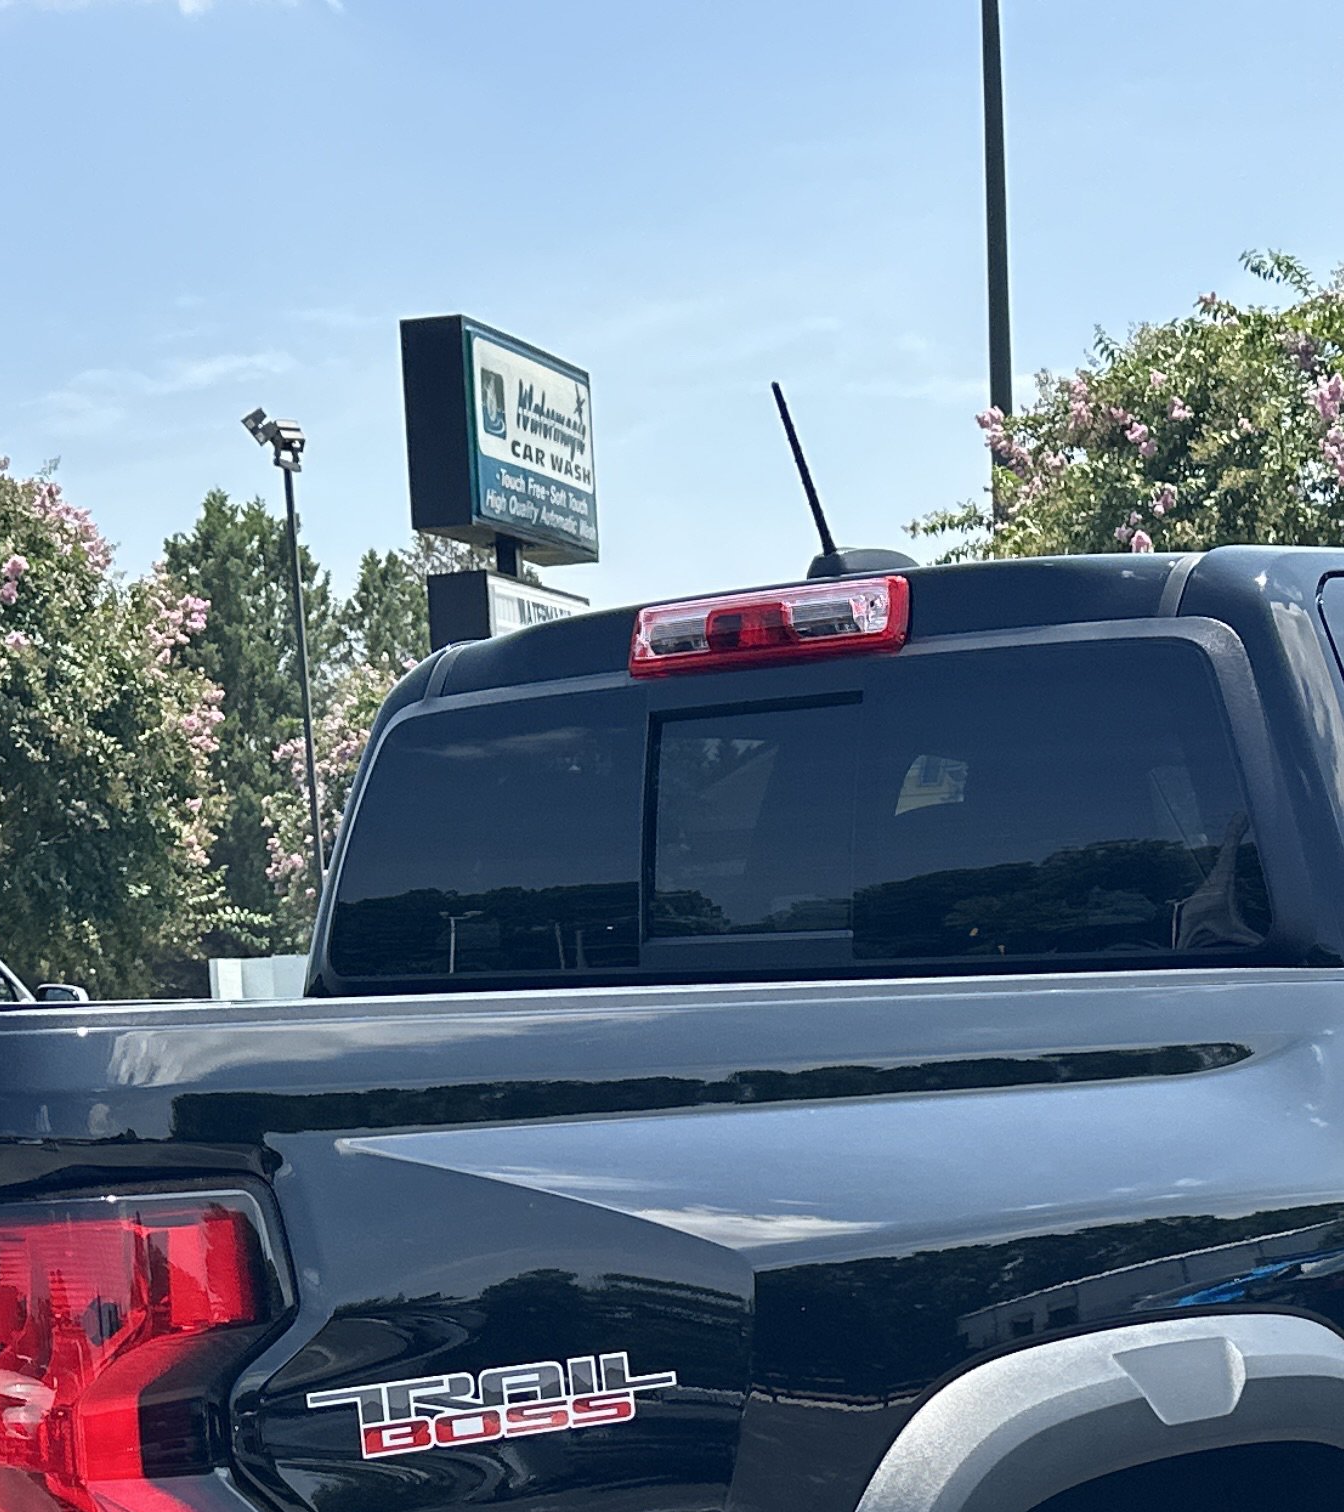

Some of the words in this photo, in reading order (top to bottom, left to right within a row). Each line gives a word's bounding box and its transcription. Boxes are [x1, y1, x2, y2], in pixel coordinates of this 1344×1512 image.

[511, 440, 545, 467] CAR
[551, 453, 592, 486] WASH
[486, 488, 507, 514] High
[508, 495, 540, 525] Quality
[540, 506, 578, 535] Automatic
[307, 1351, 677, 1424] TRAIL
[360, 1389, 636, 1460] BOSS
